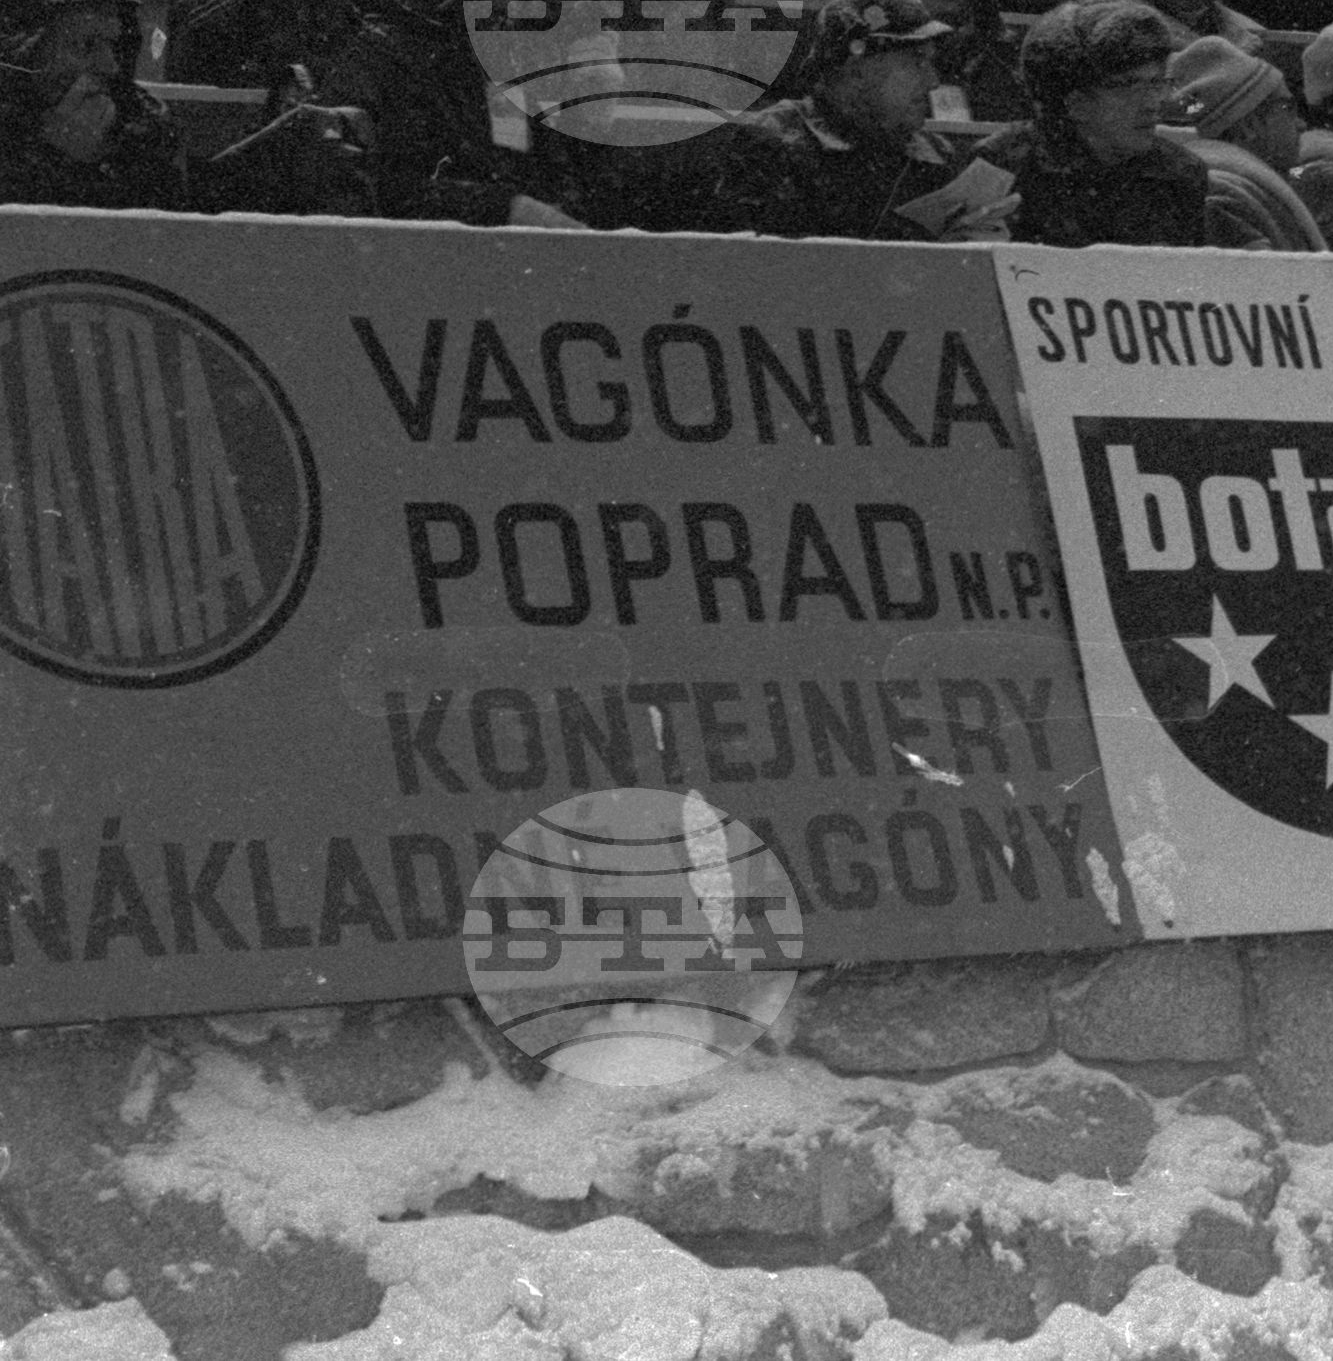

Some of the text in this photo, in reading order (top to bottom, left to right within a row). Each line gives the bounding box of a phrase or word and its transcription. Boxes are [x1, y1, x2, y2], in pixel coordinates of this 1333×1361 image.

[349, 303, 1016, 450] VAGÓNKA
[1028, 295, 1323, 370] SPORTOVNÍ
[403, 501, 1052, 629] POPRAD N.P.
[384, 676, 1055, 795] KONTEJNERY
